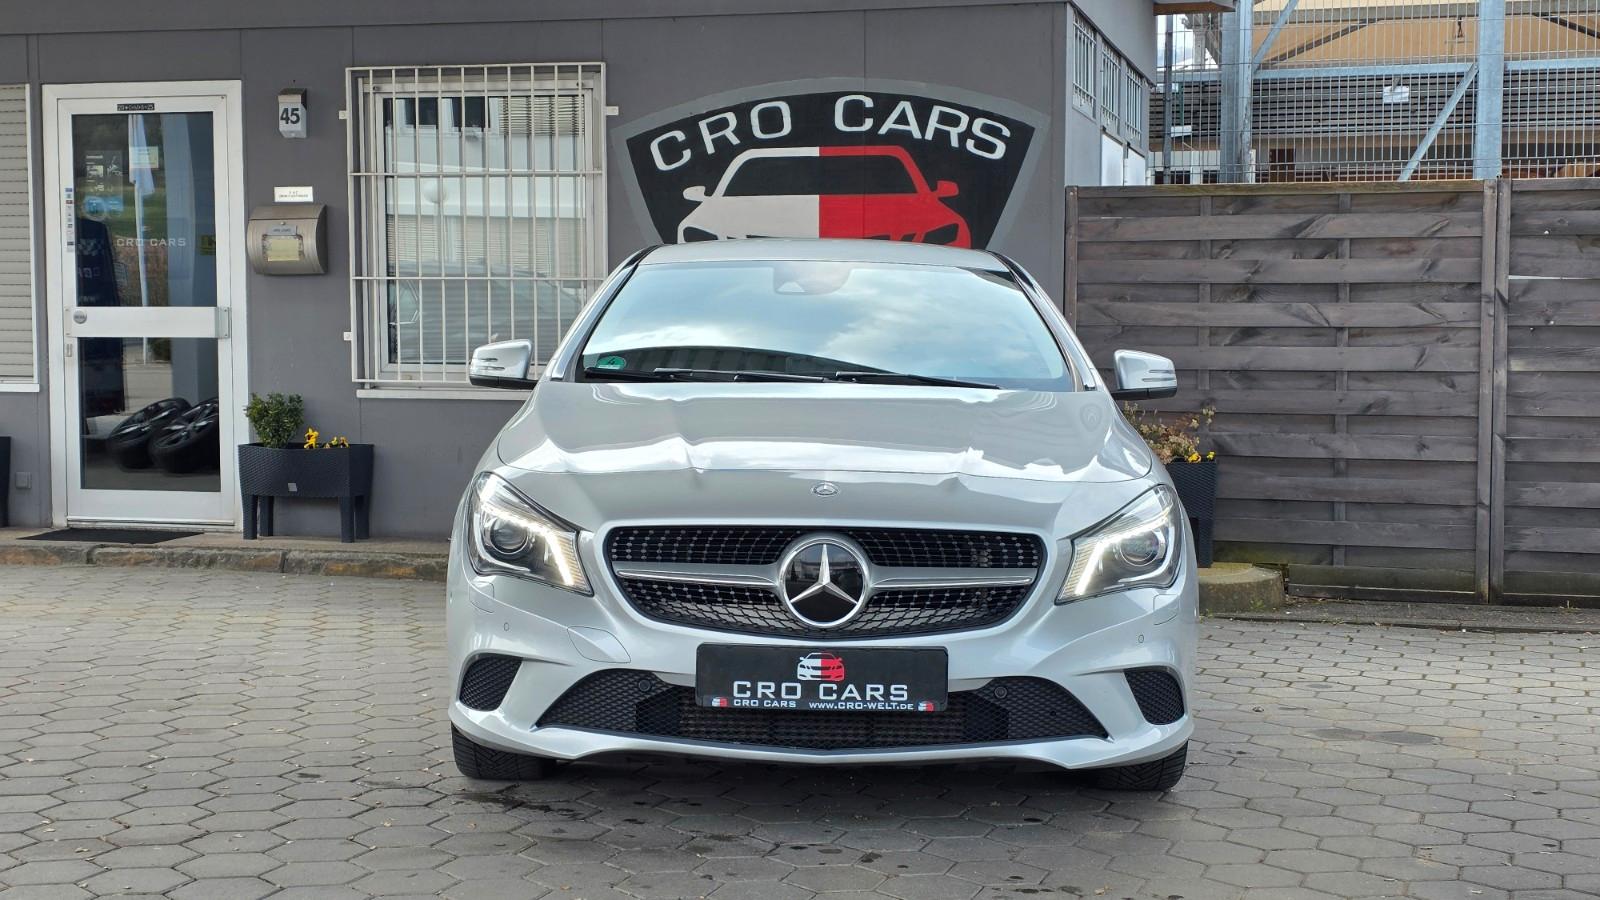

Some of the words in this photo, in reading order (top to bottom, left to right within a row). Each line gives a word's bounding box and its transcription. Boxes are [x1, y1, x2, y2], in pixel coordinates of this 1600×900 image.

[280, 107, 300, 125] 45
[649, 100, 793, 172] CRO
[834, 94, 1011, 160] CARS
[150, 238, 186, 247] CARS
[733, 680, 801, 699] CRO
[819, 683, 908, 701] CARS
[733, 699, 758, 707] CRO
[764, 700, 797, 708] CARS
